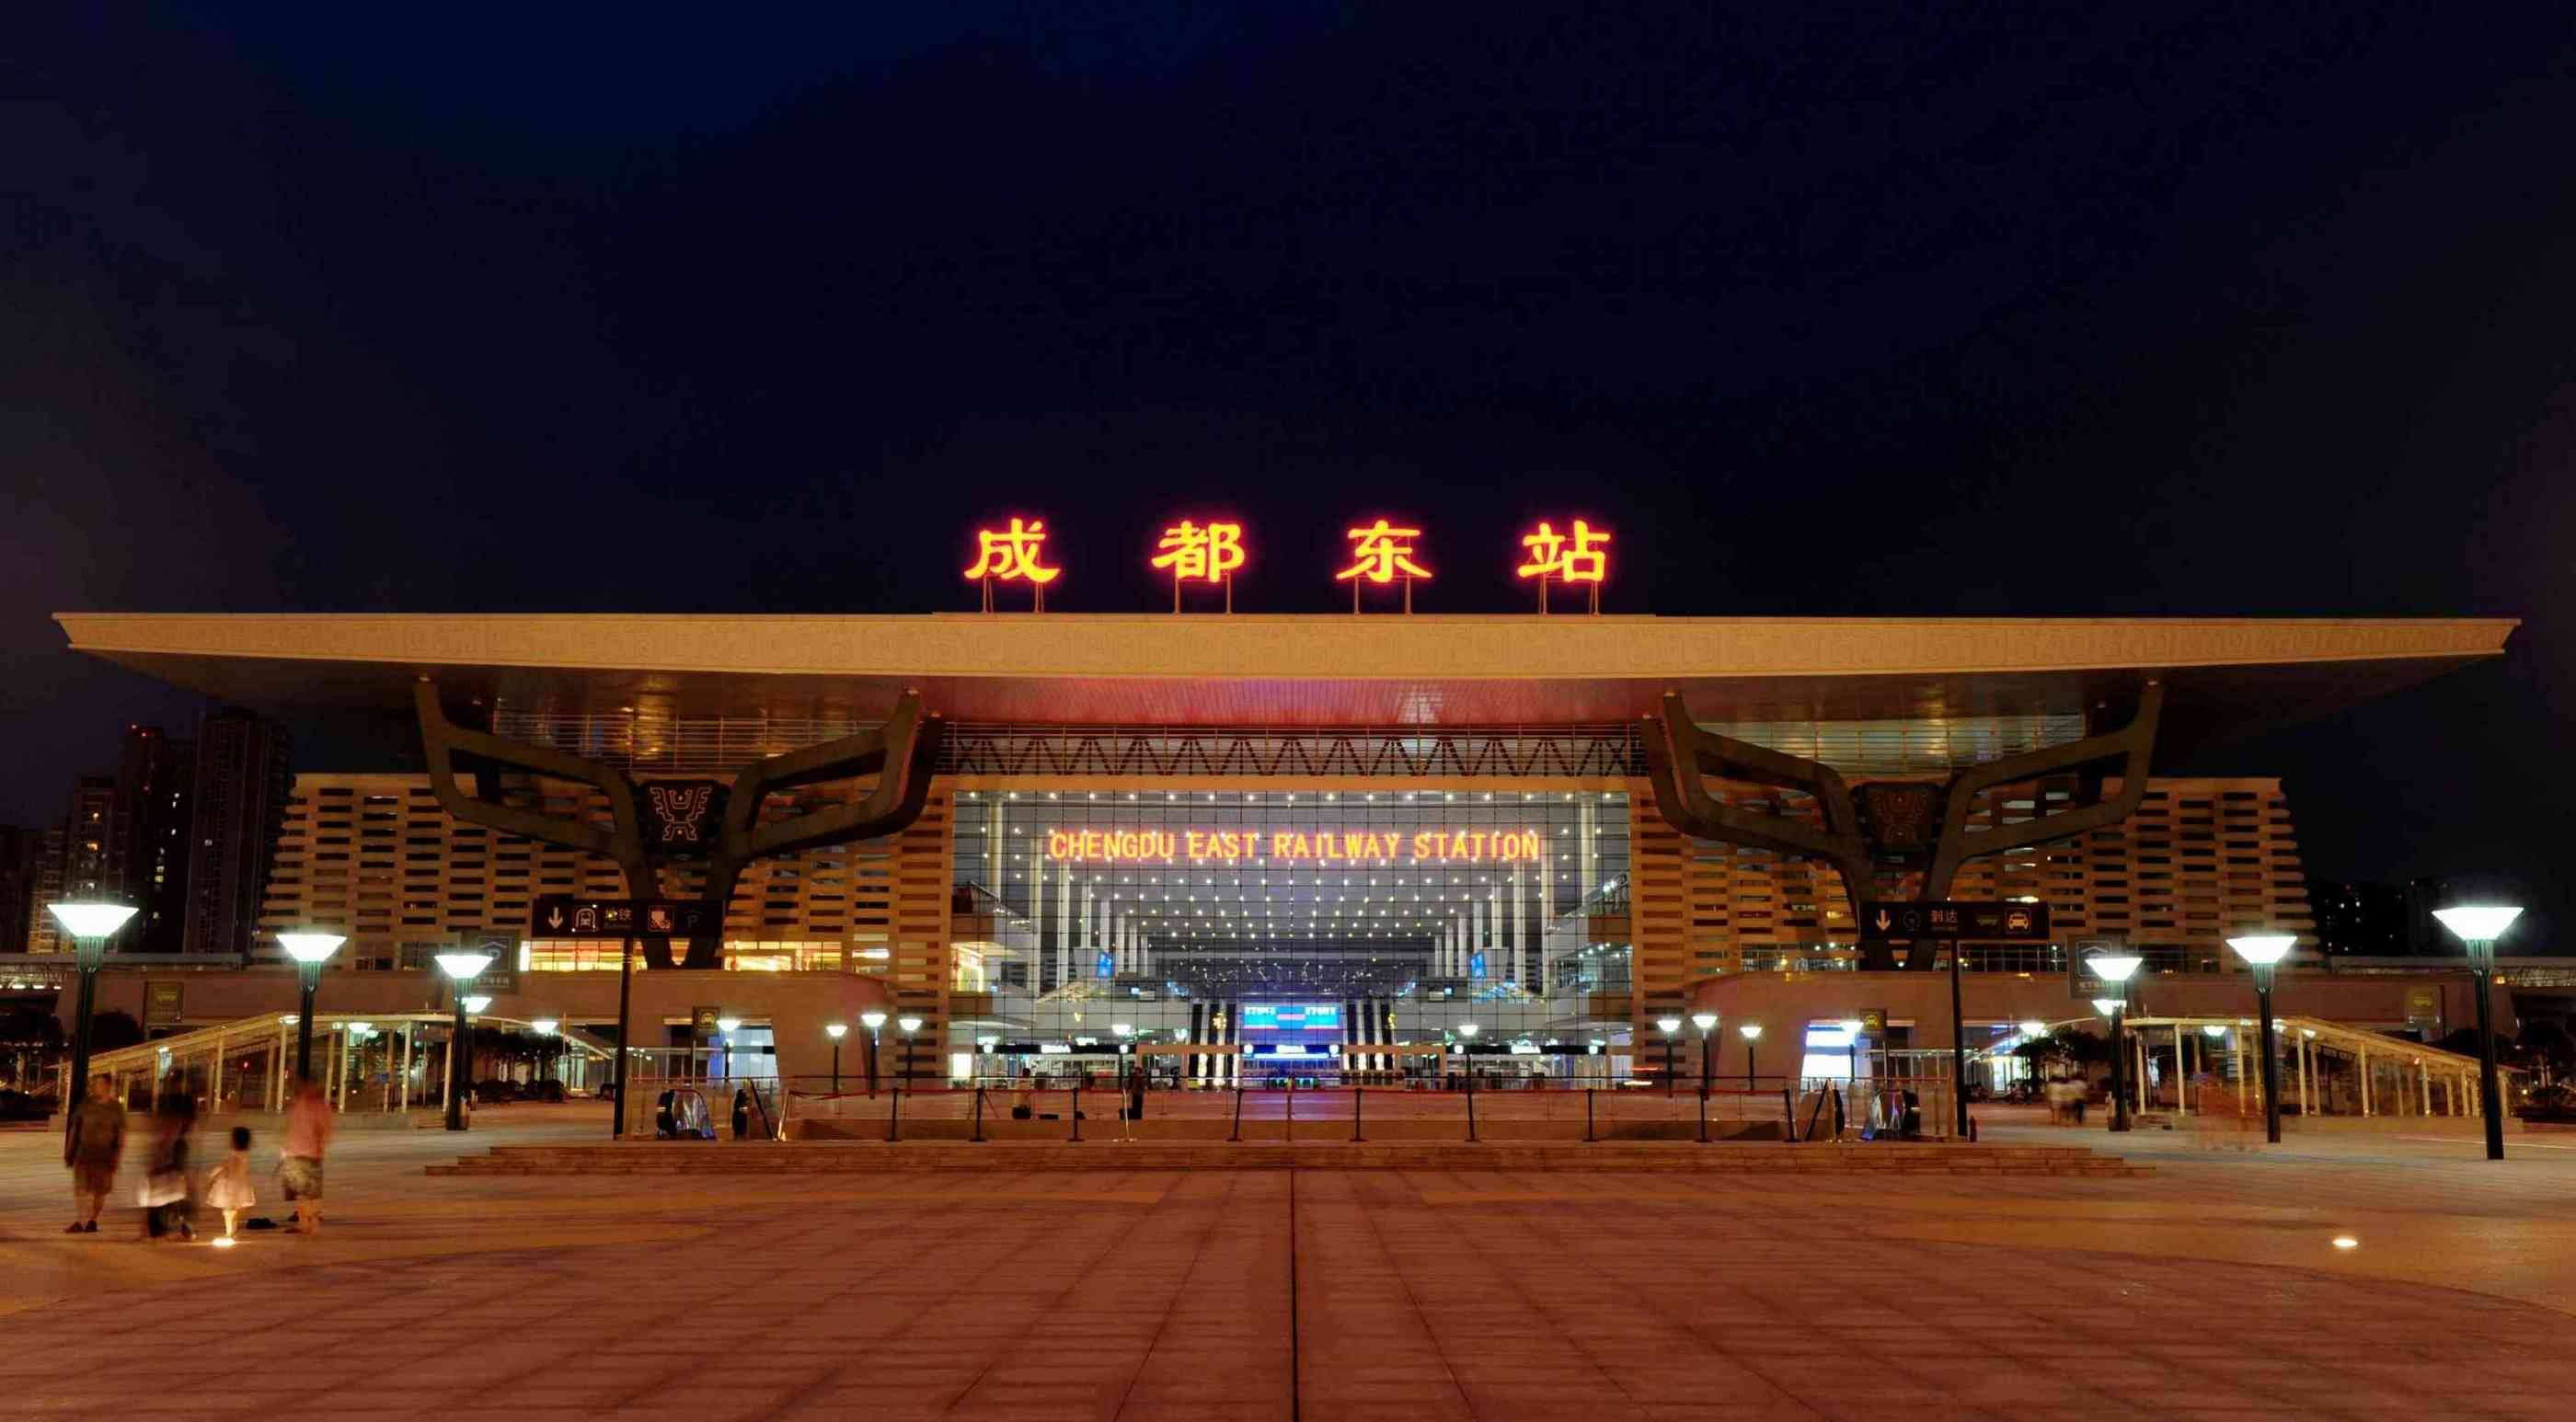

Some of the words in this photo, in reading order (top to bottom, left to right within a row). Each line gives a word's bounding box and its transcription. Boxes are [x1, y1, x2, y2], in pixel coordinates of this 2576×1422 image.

[963, 518, 1613, 583] 成都东站
[1049, 831, 1175, 859] CHENGDU
[1188, 832, 1258, 859] EAST
[1273, 831, 1401, 859] RAILWAY
[1413, 831, 1541, 860] STATION
